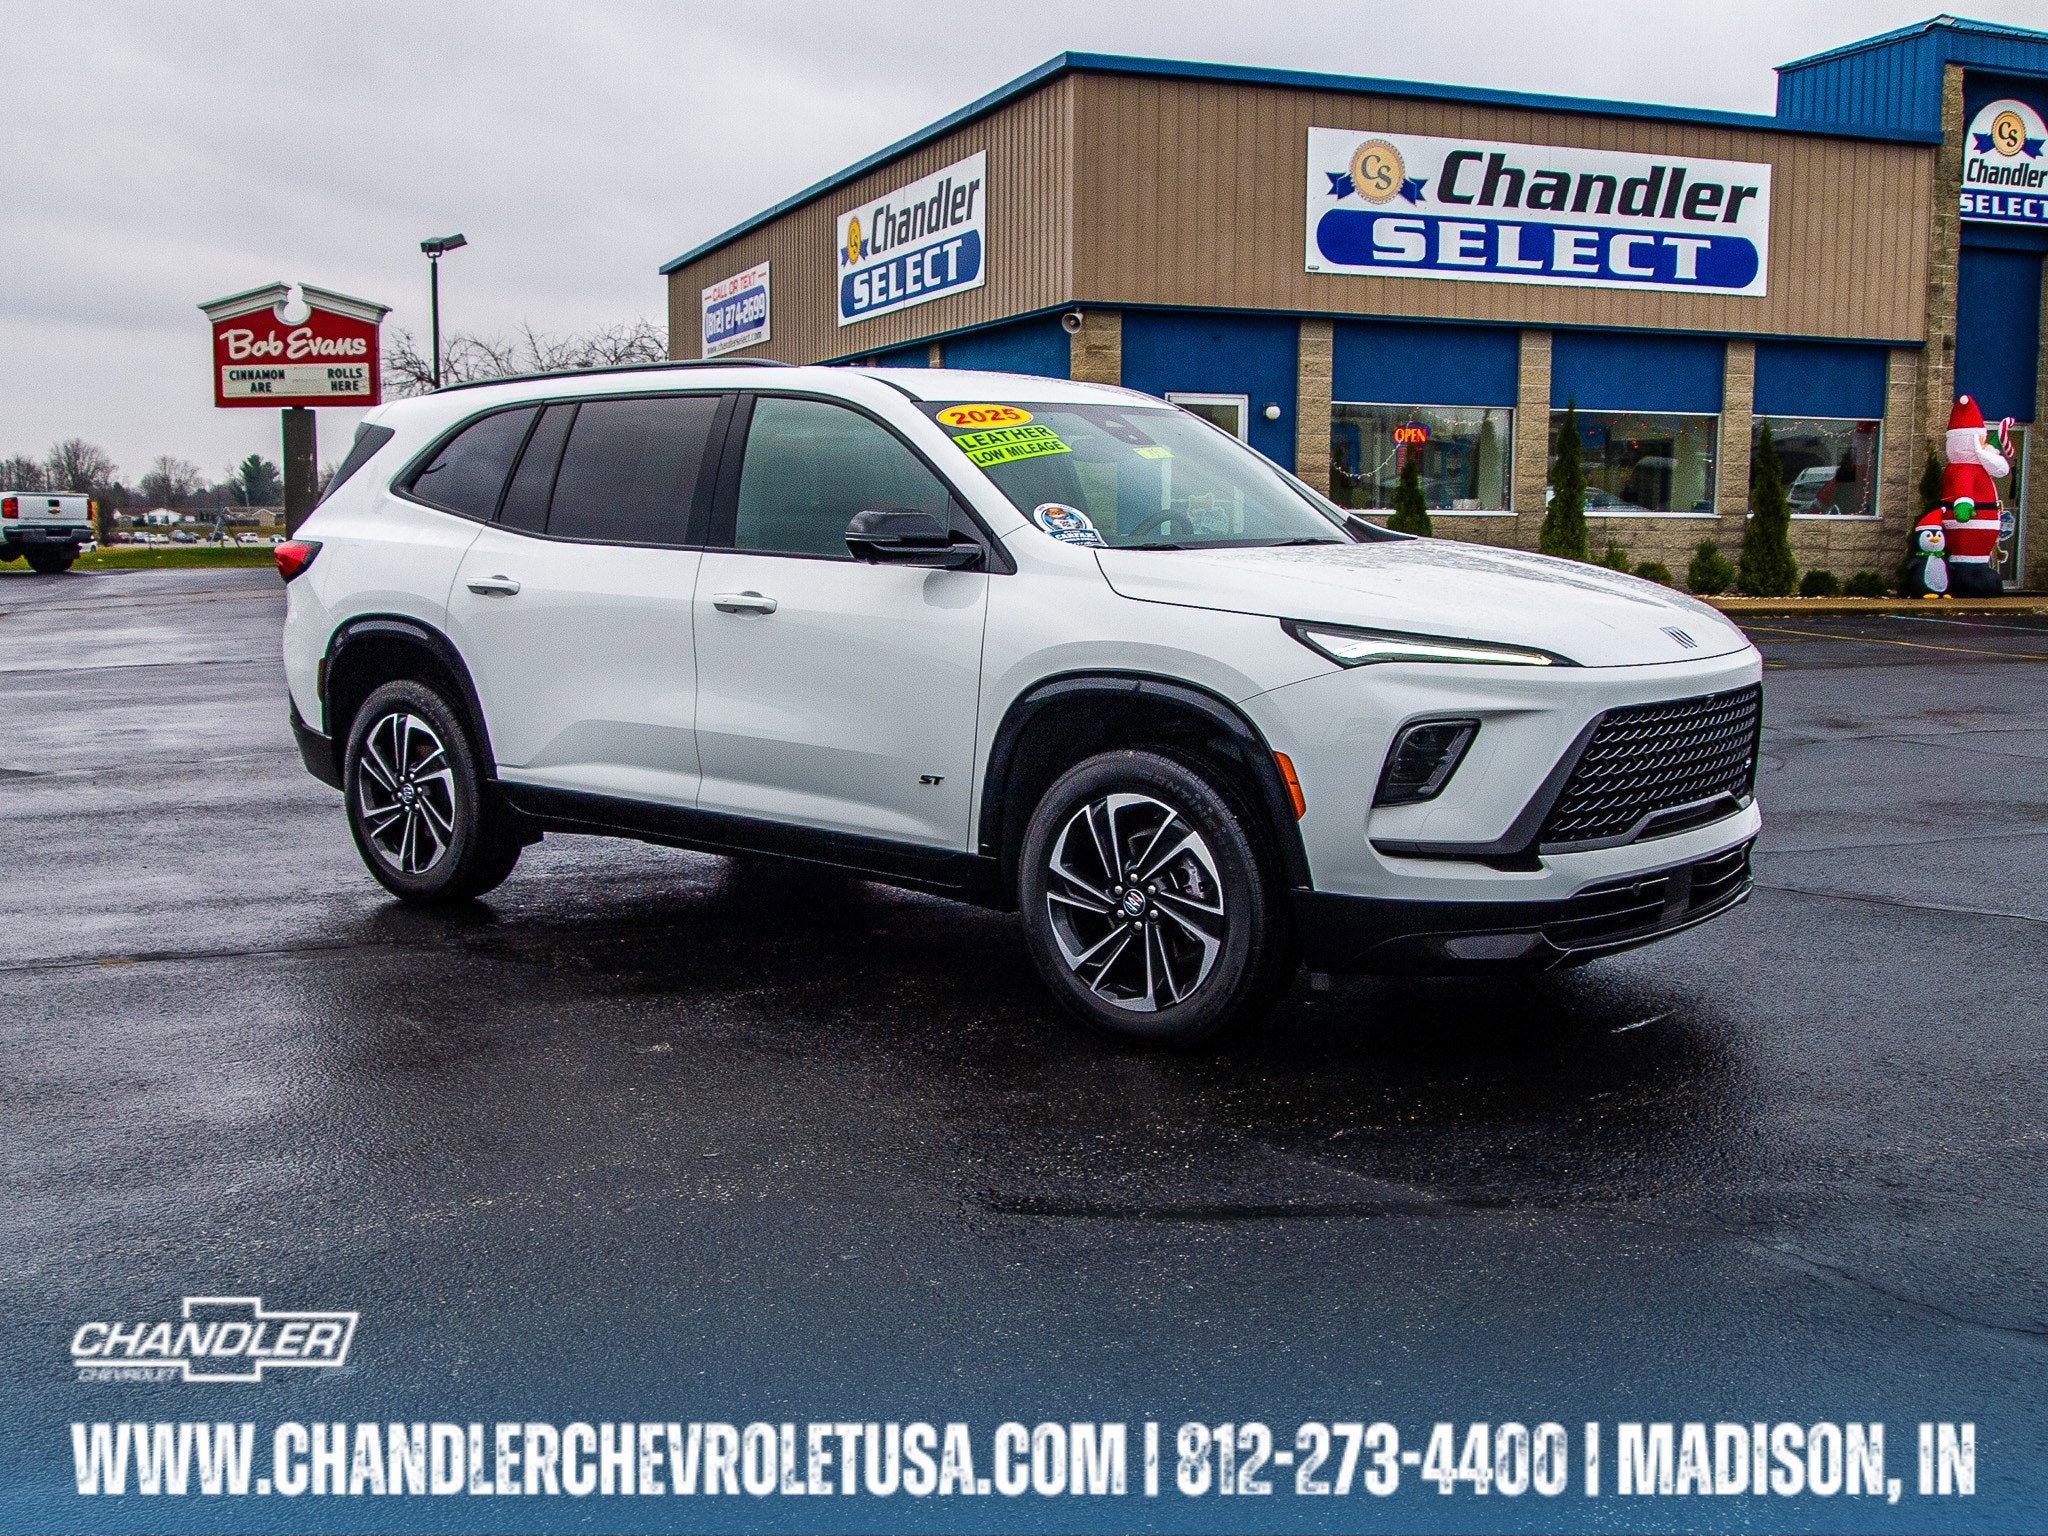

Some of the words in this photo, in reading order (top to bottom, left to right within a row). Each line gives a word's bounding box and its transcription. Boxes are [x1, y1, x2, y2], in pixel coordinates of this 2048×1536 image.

[1966, 158, 2048, 188] Chandler
[1437, 149, 1759, 224] Chandler
[871, 177, 981, 255] Chandler
[1960, 193, 2048, 219] SELECT
[1372, 217, 1713, 280] SELECT
[713, 283, 727, 302] CALL
[729, 278, 738, 295] OR
[741, 271, 756, 289] TEXT
[853, 238, 963, 311] SELECT
[219, 329, 284, 360] Bob
[286, 327, 368, 360] Evans
[229, 369, 285, 381] CINNAMON
[327, 368, 363, 379] ROLLS
[250, 382, 272, 393] ARE
[331, 380, 359, 391] HERE
[950, 408, 1021, 425] 2025
[960, 426, 1054, 449] LEATHER
[1394, 428, 1427, 443] OPEN
[973, 449, 1005, 464] LOW
[1005, 440, 1064, 457] MILEAGE
[919, 774, 945, 786] ST
